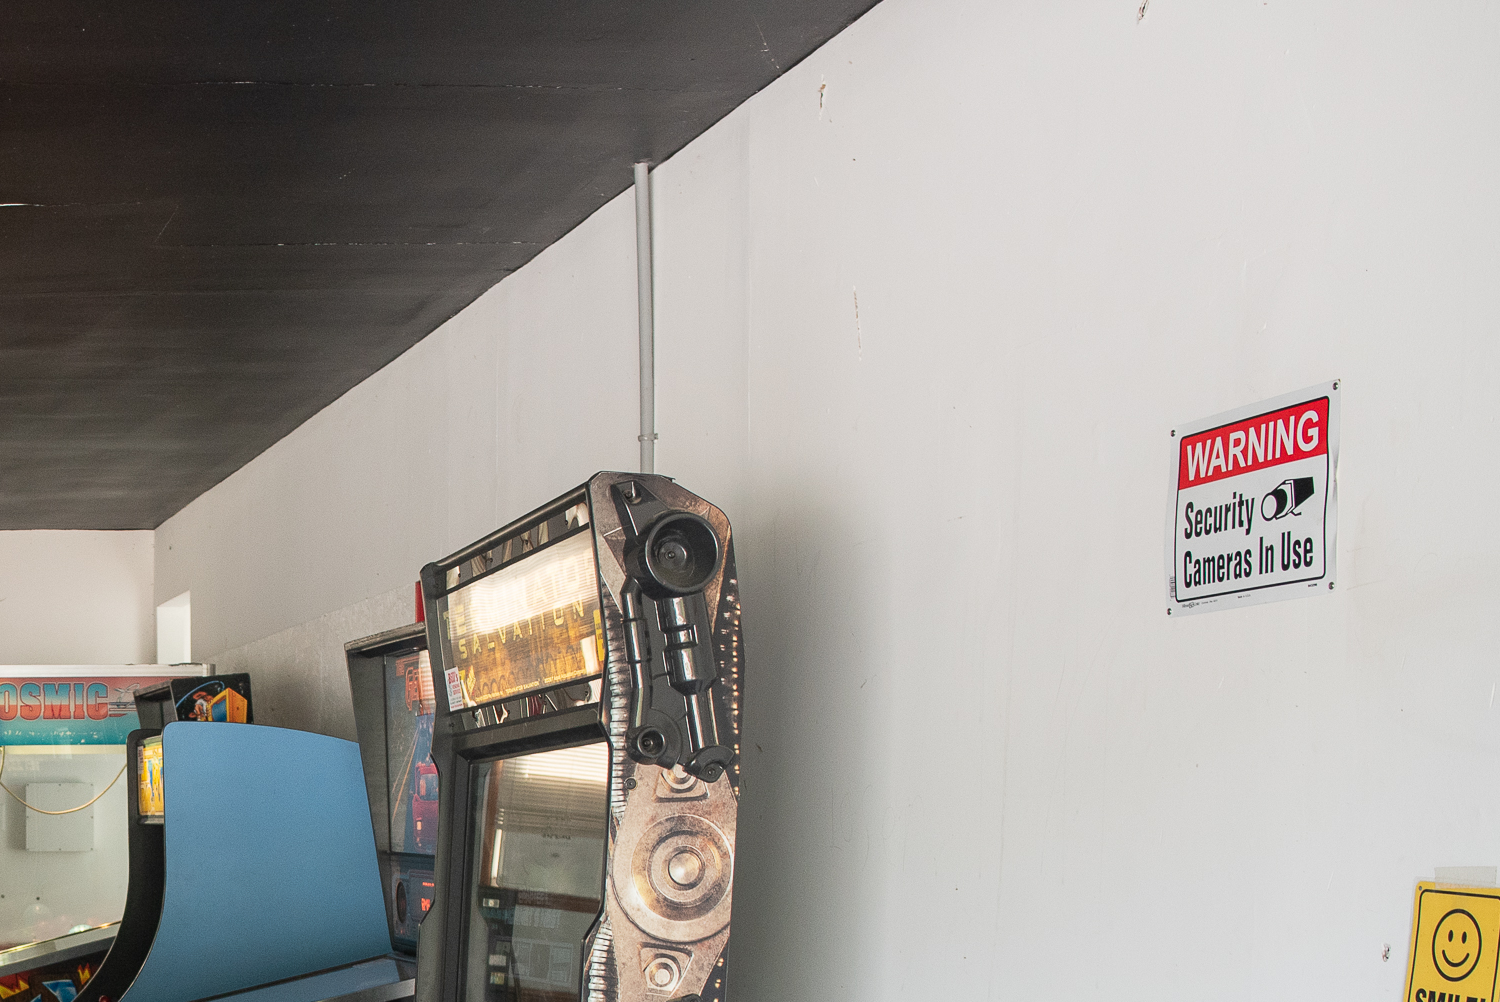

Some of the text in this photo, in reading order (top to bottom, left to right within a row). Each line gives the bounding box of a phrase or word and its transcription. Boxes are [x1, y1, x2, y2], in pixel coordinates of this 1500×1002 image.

[1186, 410, 1320, 482] WARNING
[1184, 491, 1255, 540] Security
[1183, 548, 1252, 588] Cameras
[1258, 536, 1275, 575] In
[1280, 530, 1314, 571] Use
